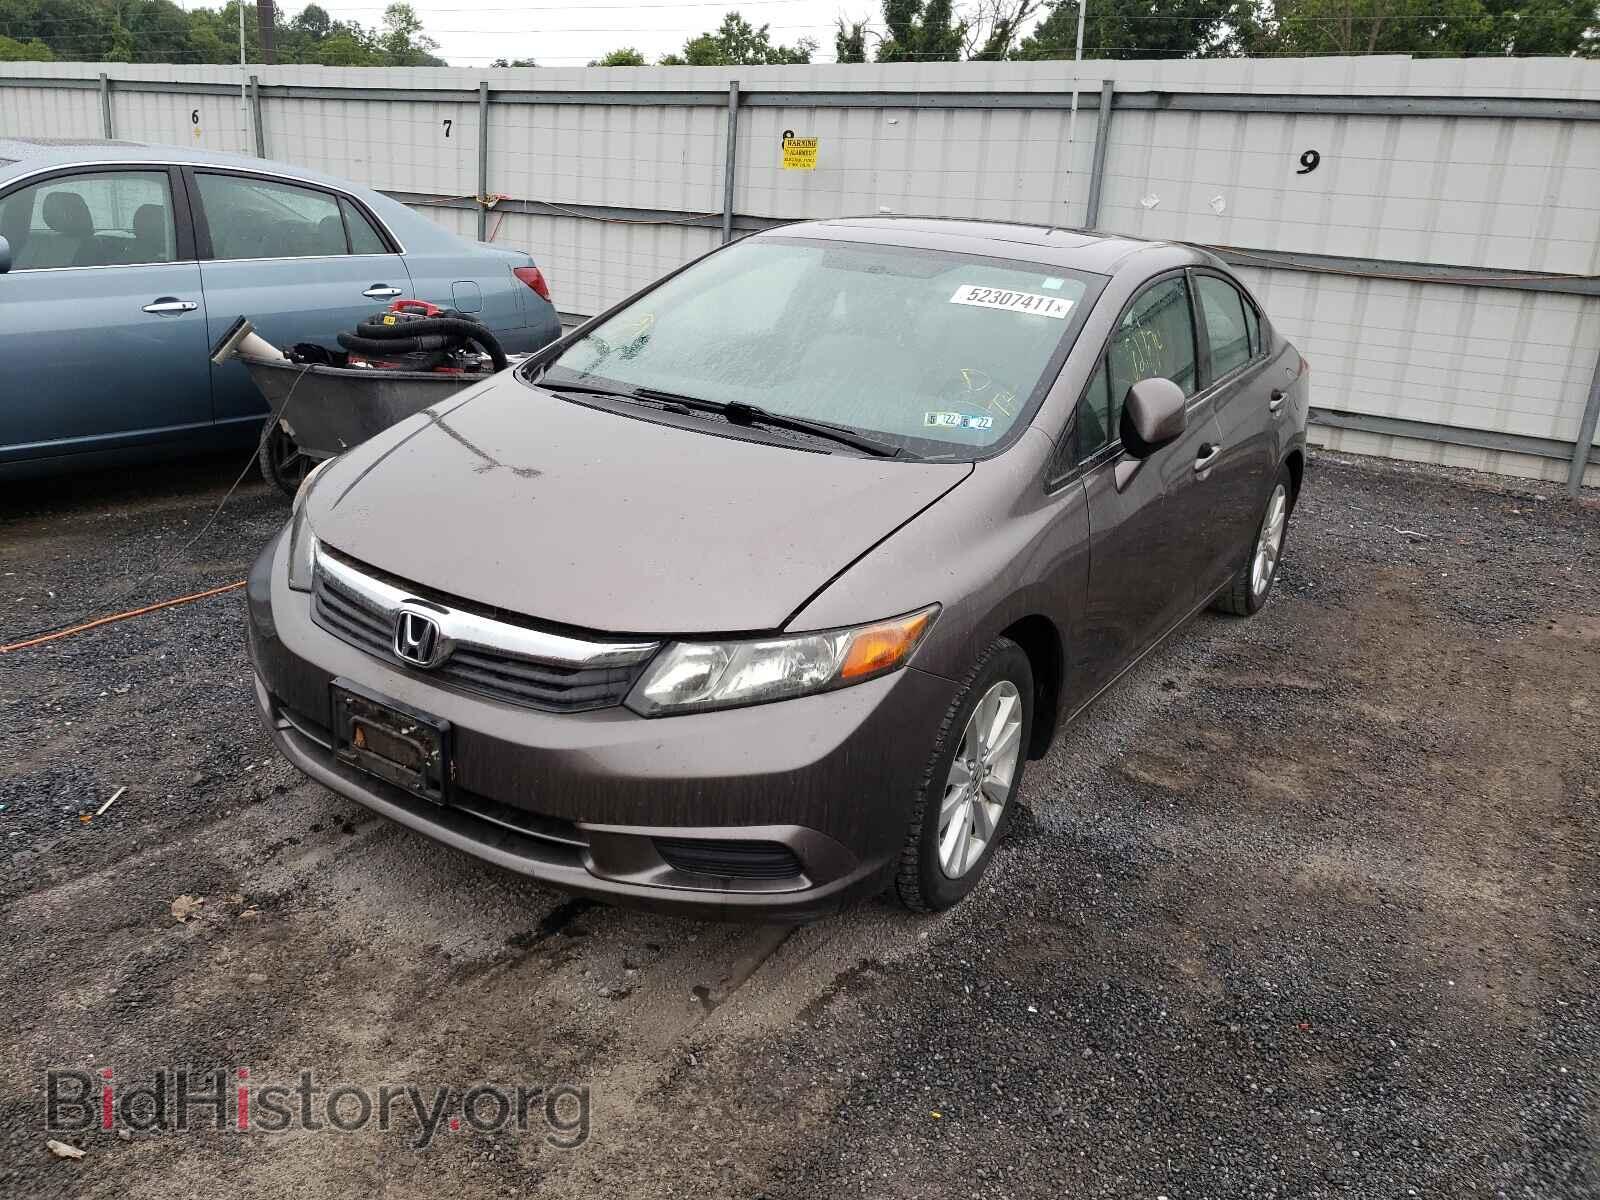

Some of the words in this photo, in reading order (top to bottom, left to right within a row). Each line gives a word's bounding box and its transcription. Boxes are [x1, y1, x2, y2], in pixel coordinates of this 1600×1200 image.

[192, 110, 199, 124] 6
[443, 119, 452, 137] 7
[1296, 149, 1320, 174] 9
